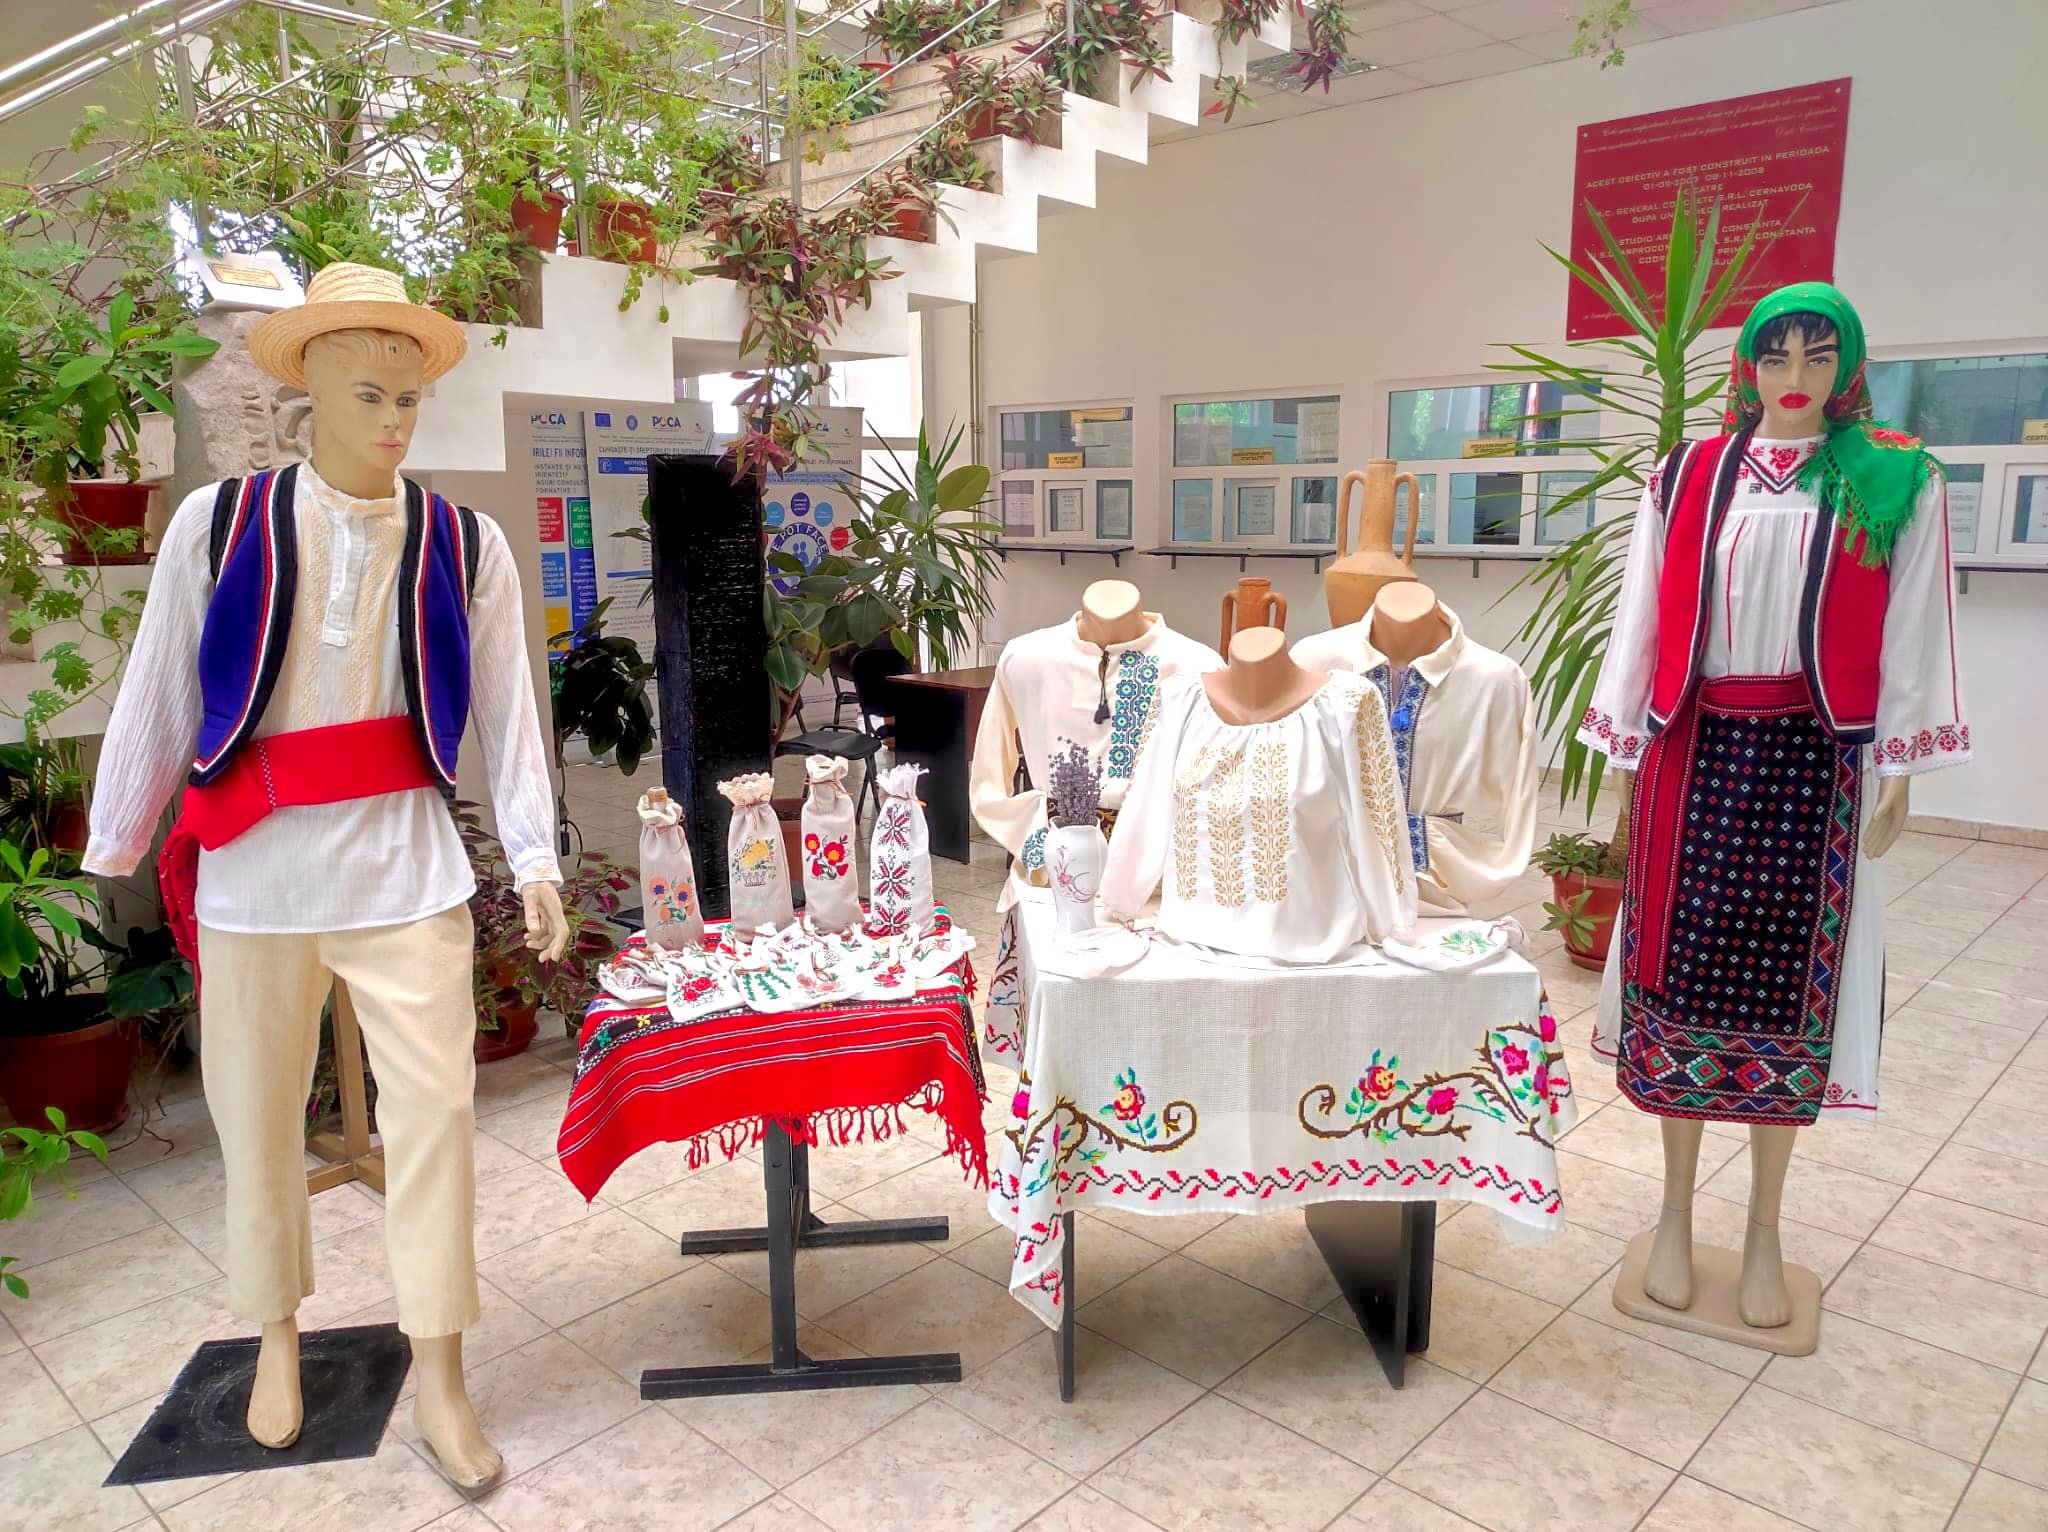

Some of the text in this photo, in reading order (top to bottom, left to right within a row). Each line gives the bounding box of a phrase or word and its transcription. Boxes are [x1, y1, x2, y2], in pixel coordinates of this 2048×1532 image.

[1586, 178, 1615, 188] ACEST
[1618, 172, 1660, 184] OBIECTIV
[1672, 165, 1698, 176] FOST
[1700, 157, 1759, 171] CONSTRUIT
[1760, 154, 1772, 162] IN
[1775, 145, 1830, 160] PERIOADA
[1616, 203, 1659, 215] GENERAL
[1749, 182, 1813, 197] CERNAVODA
[1722, 198, 1769, 212] REALIZAT
[1619, 235, 1653, 246] STUDIO
[780, 523, 802, 541] POT
[806, 525, 829, 553] FACE
